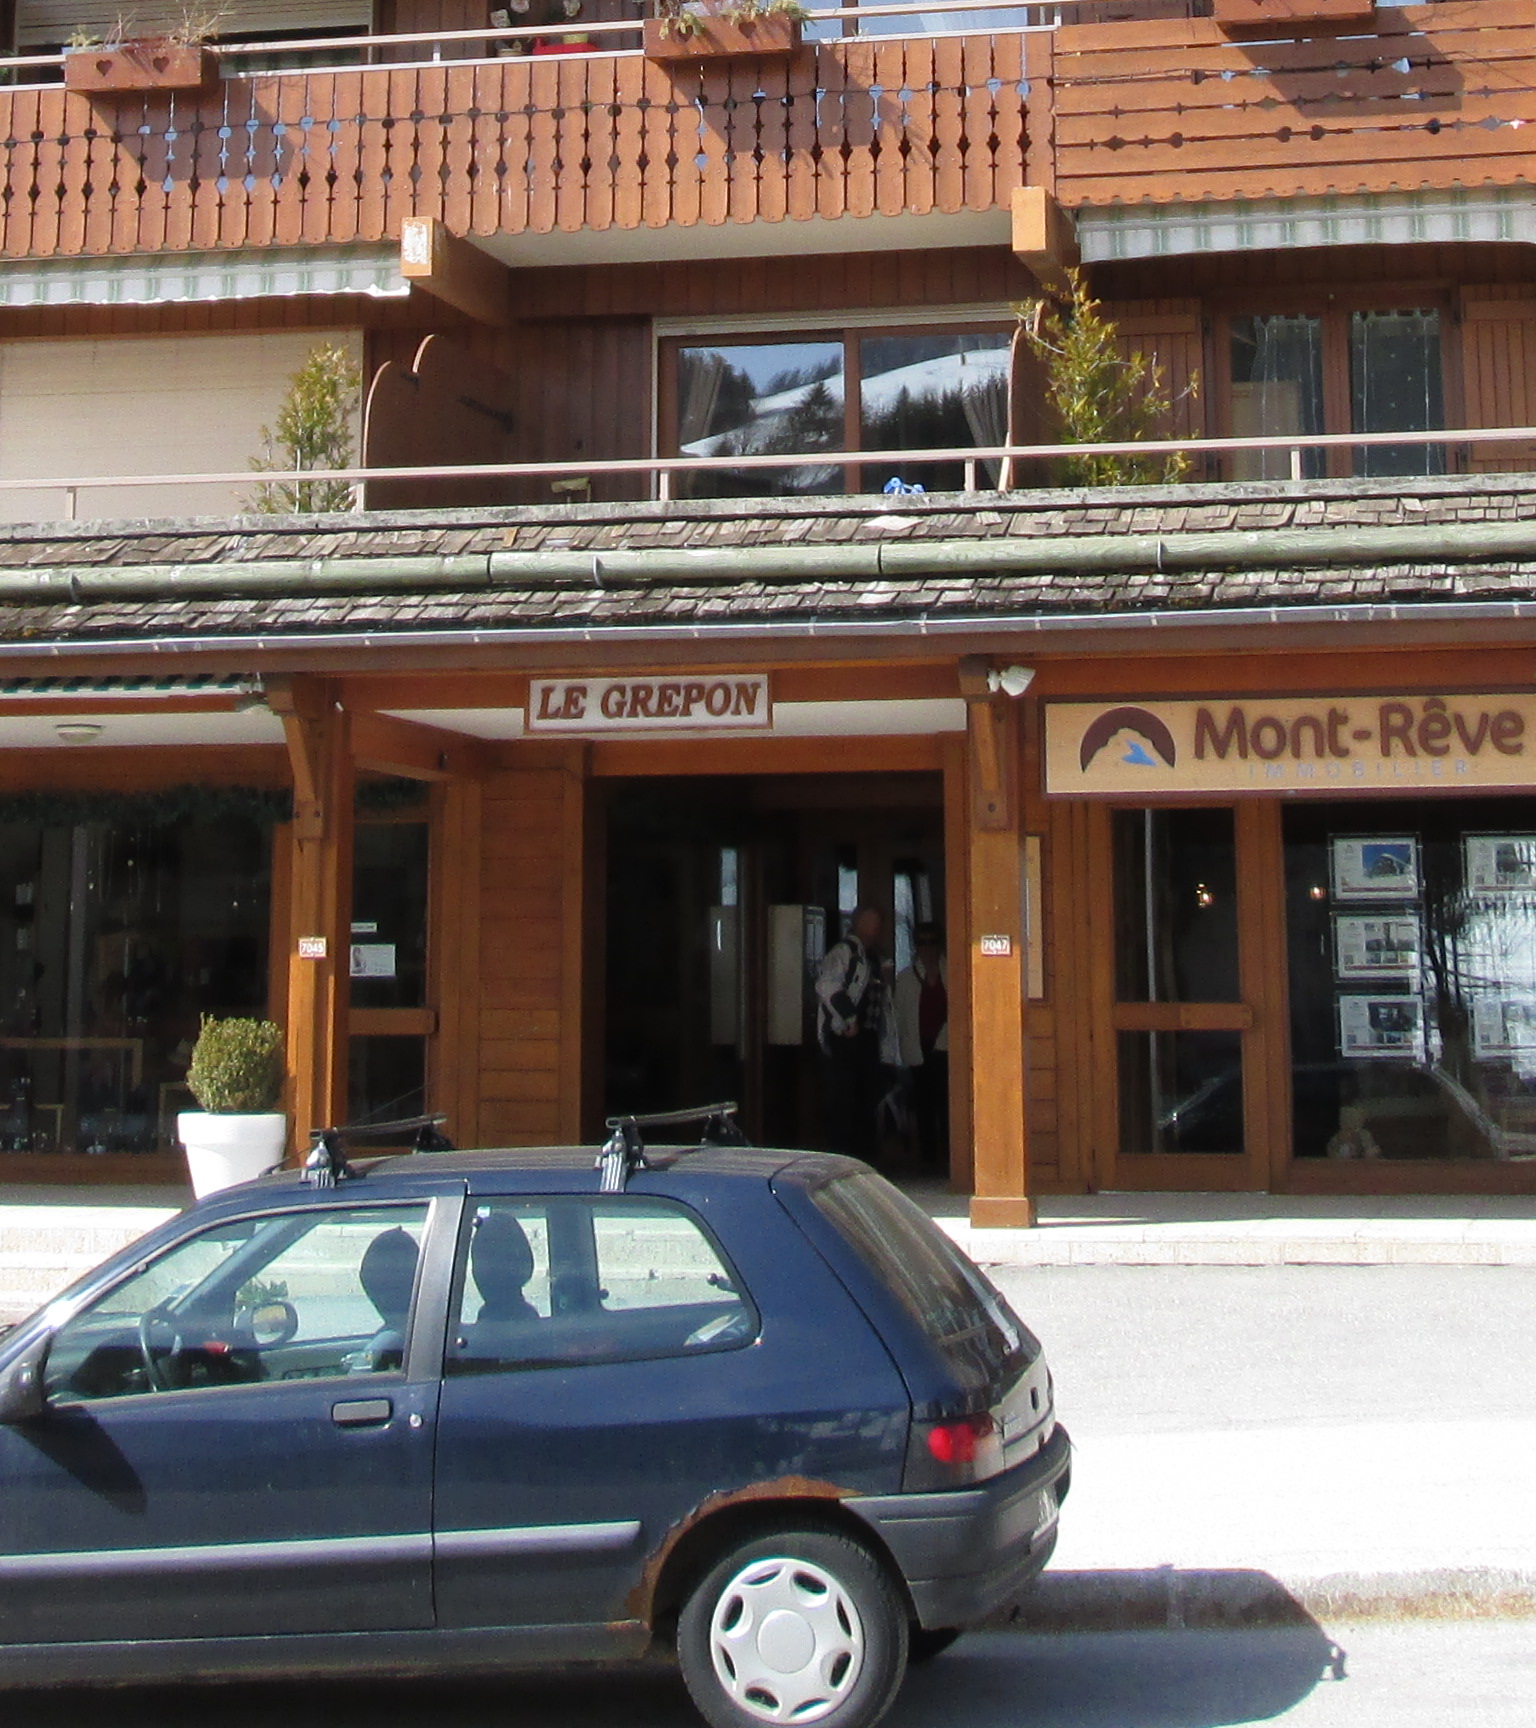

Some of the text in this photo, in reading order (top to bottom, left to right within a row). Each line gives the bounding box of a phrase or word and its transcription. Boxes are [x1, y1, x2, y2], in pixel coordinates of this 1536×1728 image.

[536, 681, 762, 720] LE GREPON
[1193, 697, 1527, 760] Mont-Rêve
[1248, 759, 1470, 779] IMMOBILIER
